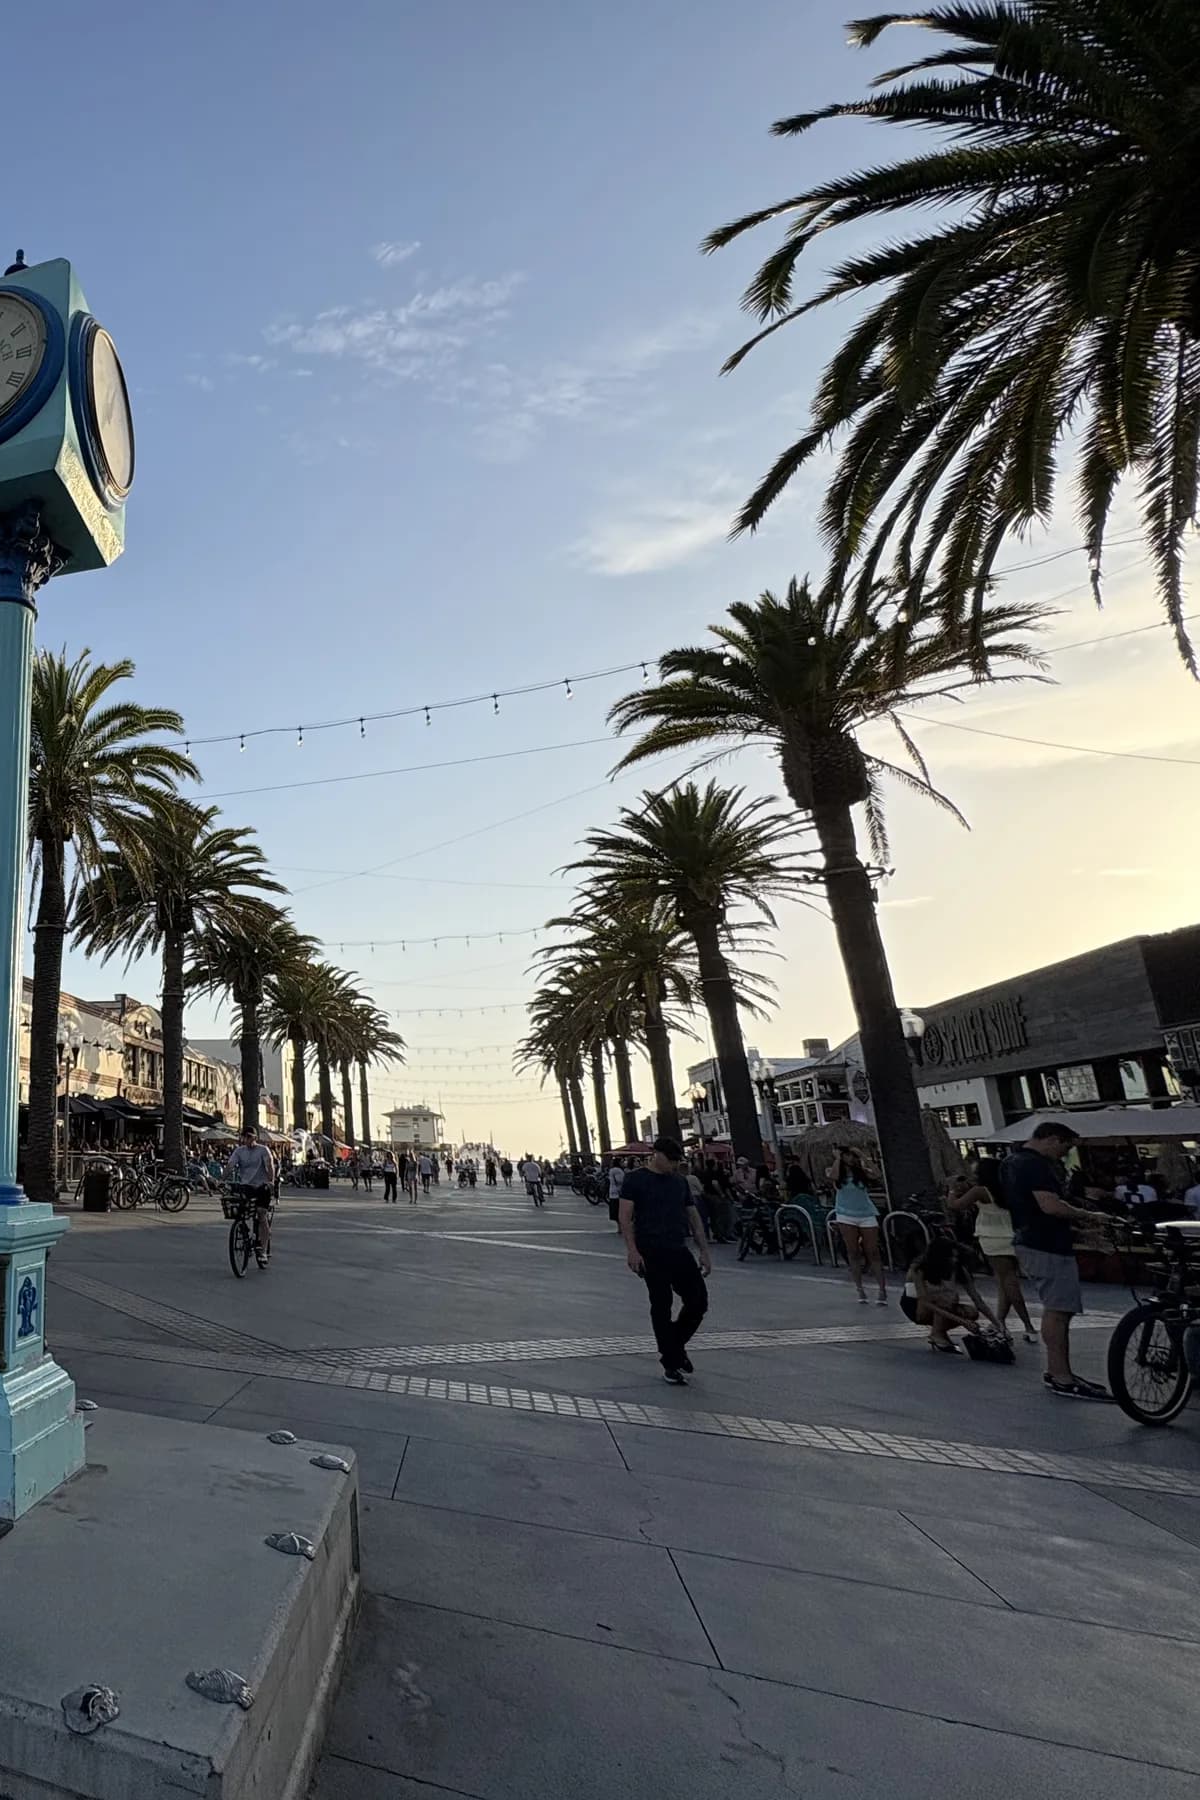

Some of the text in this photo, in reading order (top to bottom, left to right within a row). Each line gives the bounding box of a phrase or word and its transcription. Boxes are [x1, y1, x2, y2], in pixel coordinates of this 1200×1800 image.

[10, 322, 26, 338] II
[16, 345, 33, 359] III
[988, 995, 1028, 1051] SURF
